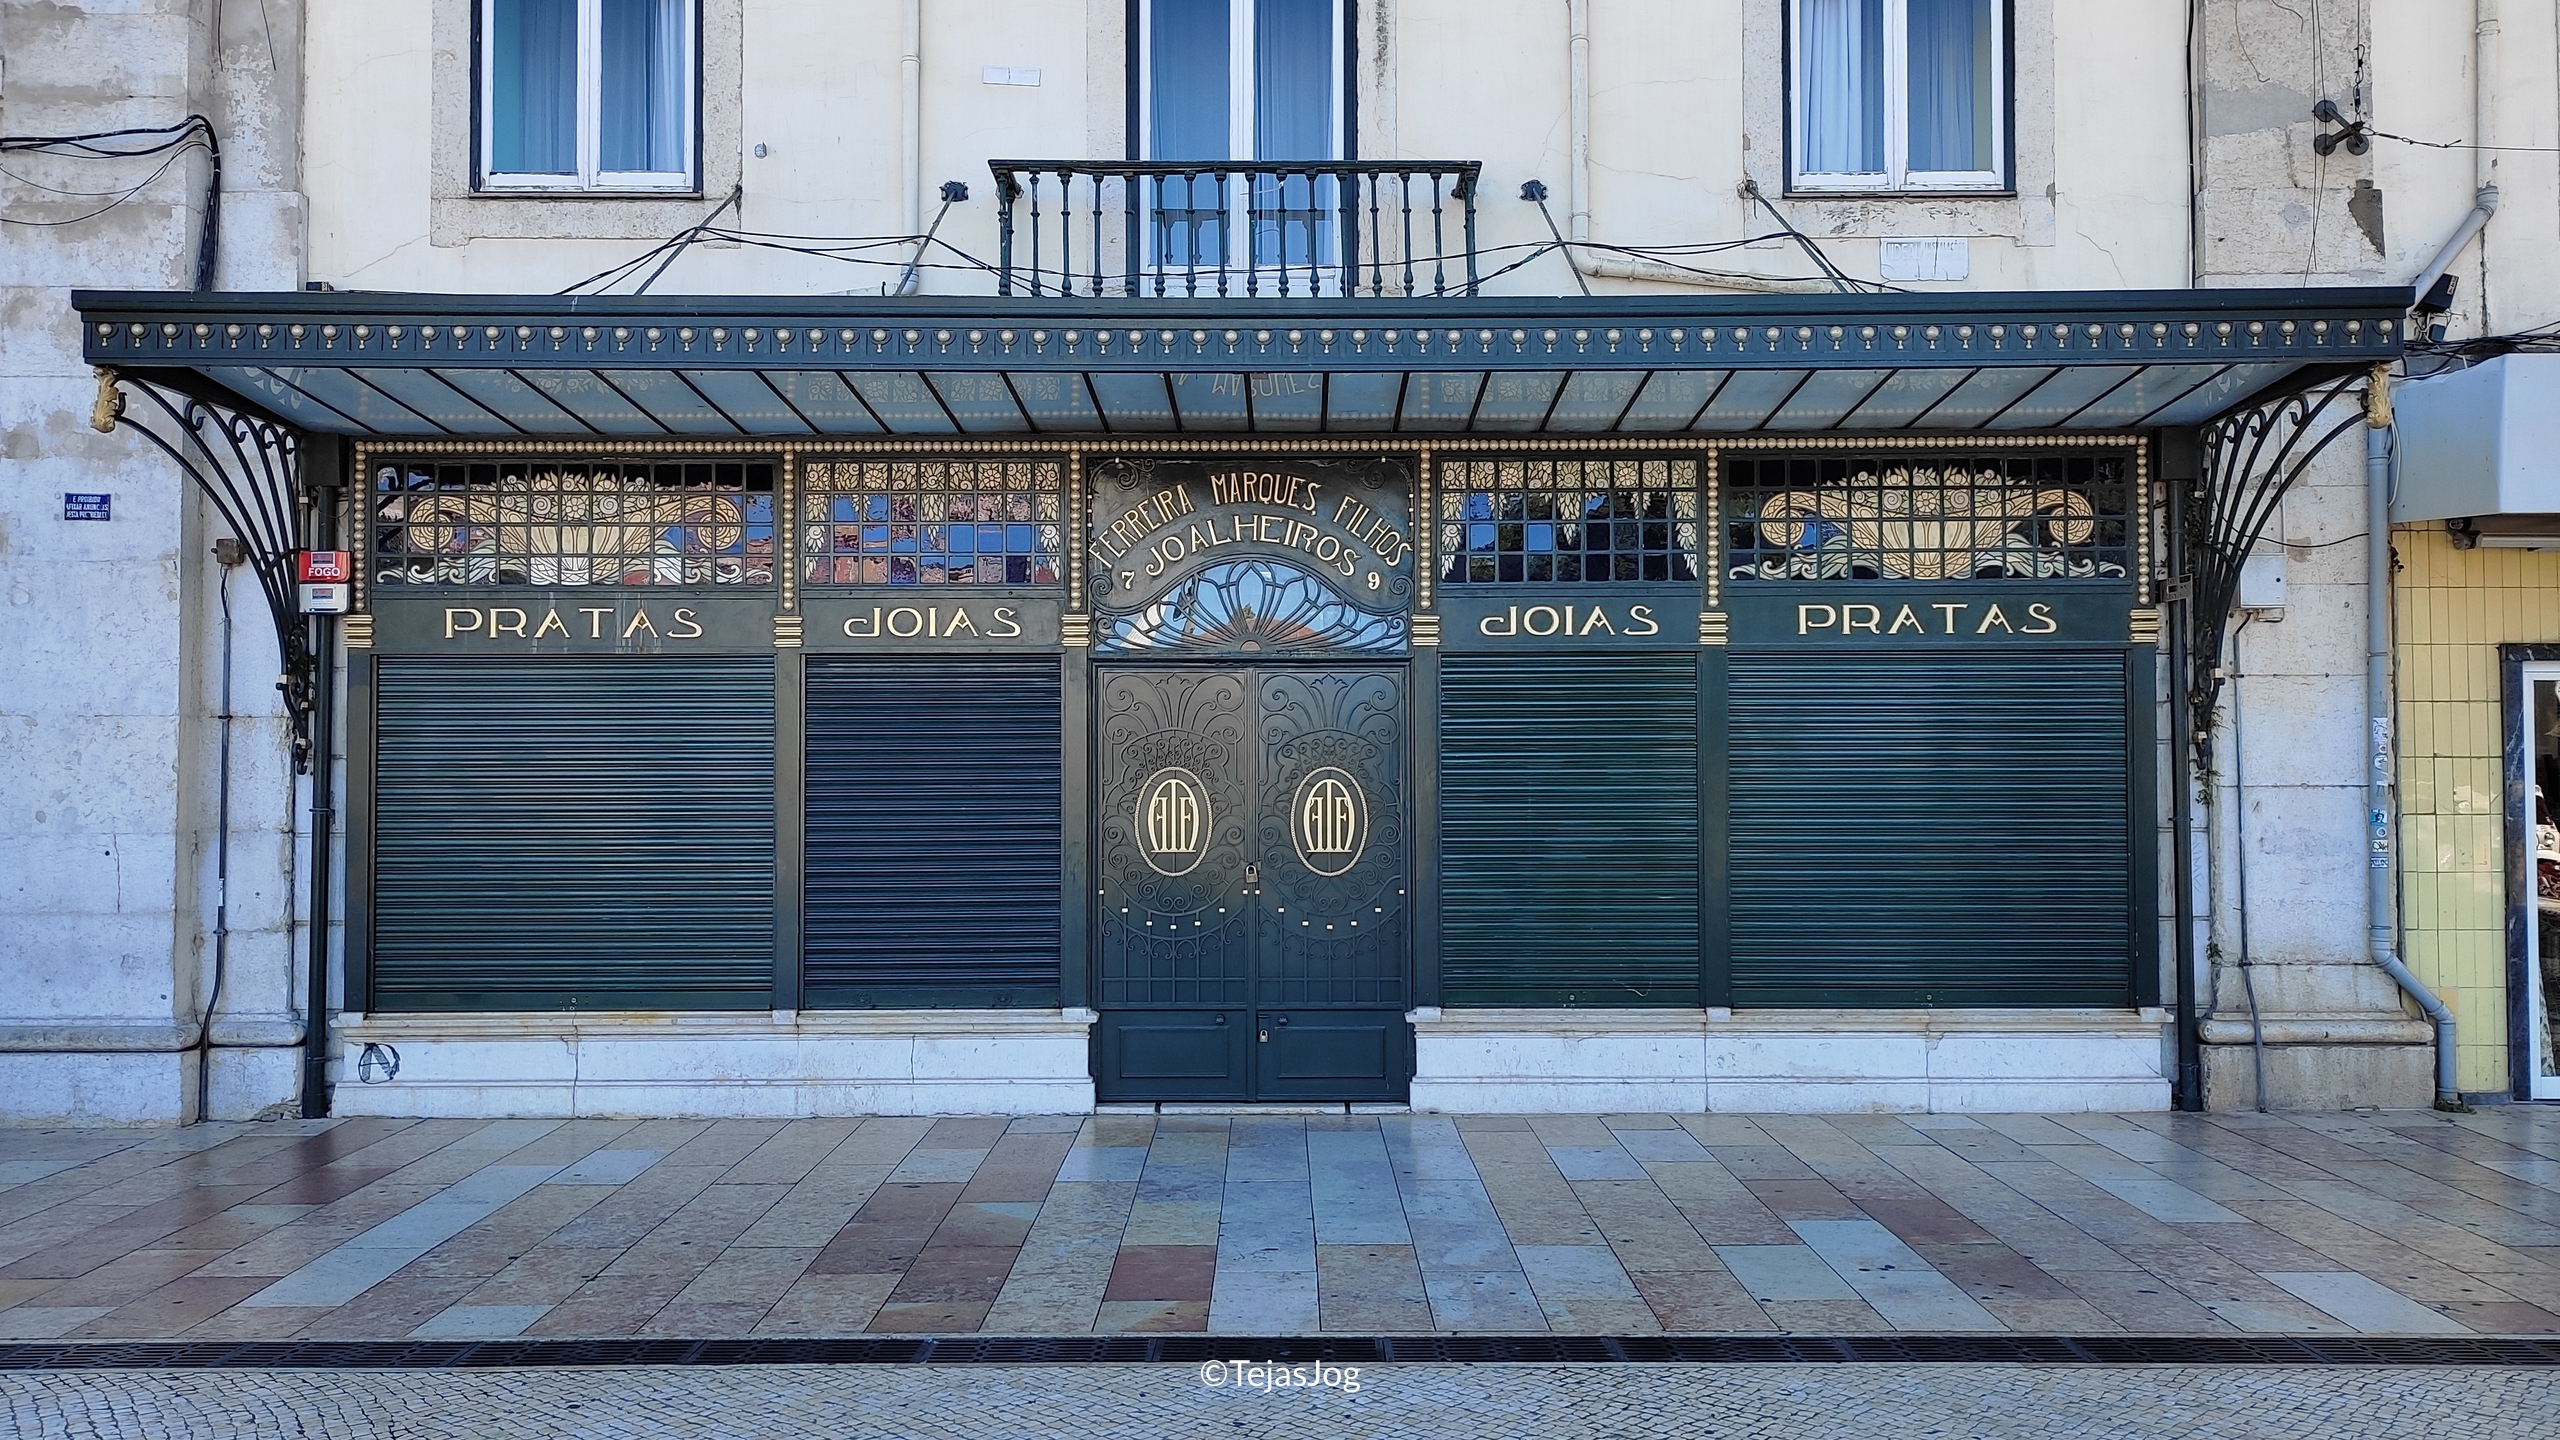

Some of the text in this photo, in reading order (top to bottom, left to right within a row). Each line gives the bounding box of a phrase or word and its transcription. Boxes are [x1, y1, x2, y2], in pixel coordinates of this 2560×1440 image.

[1088, 484, 1194, 568] FERREIRA
[1333, 495, 1413, 566] FILHOS
[1145, 515, 1361, 576] JOALHEIROS
[308, 567, 340, 577] FOGO
[1121, 571, 1135, 589] 7
[1367, 571, 1381, 590] 9
[444, 608, 703, 638] PRATAS
[843, 607, 1022, 638] JOIAS
[1479, 605, 1659, 636] JOIAS
[1797, 603, 2057, 635] PRATAS
